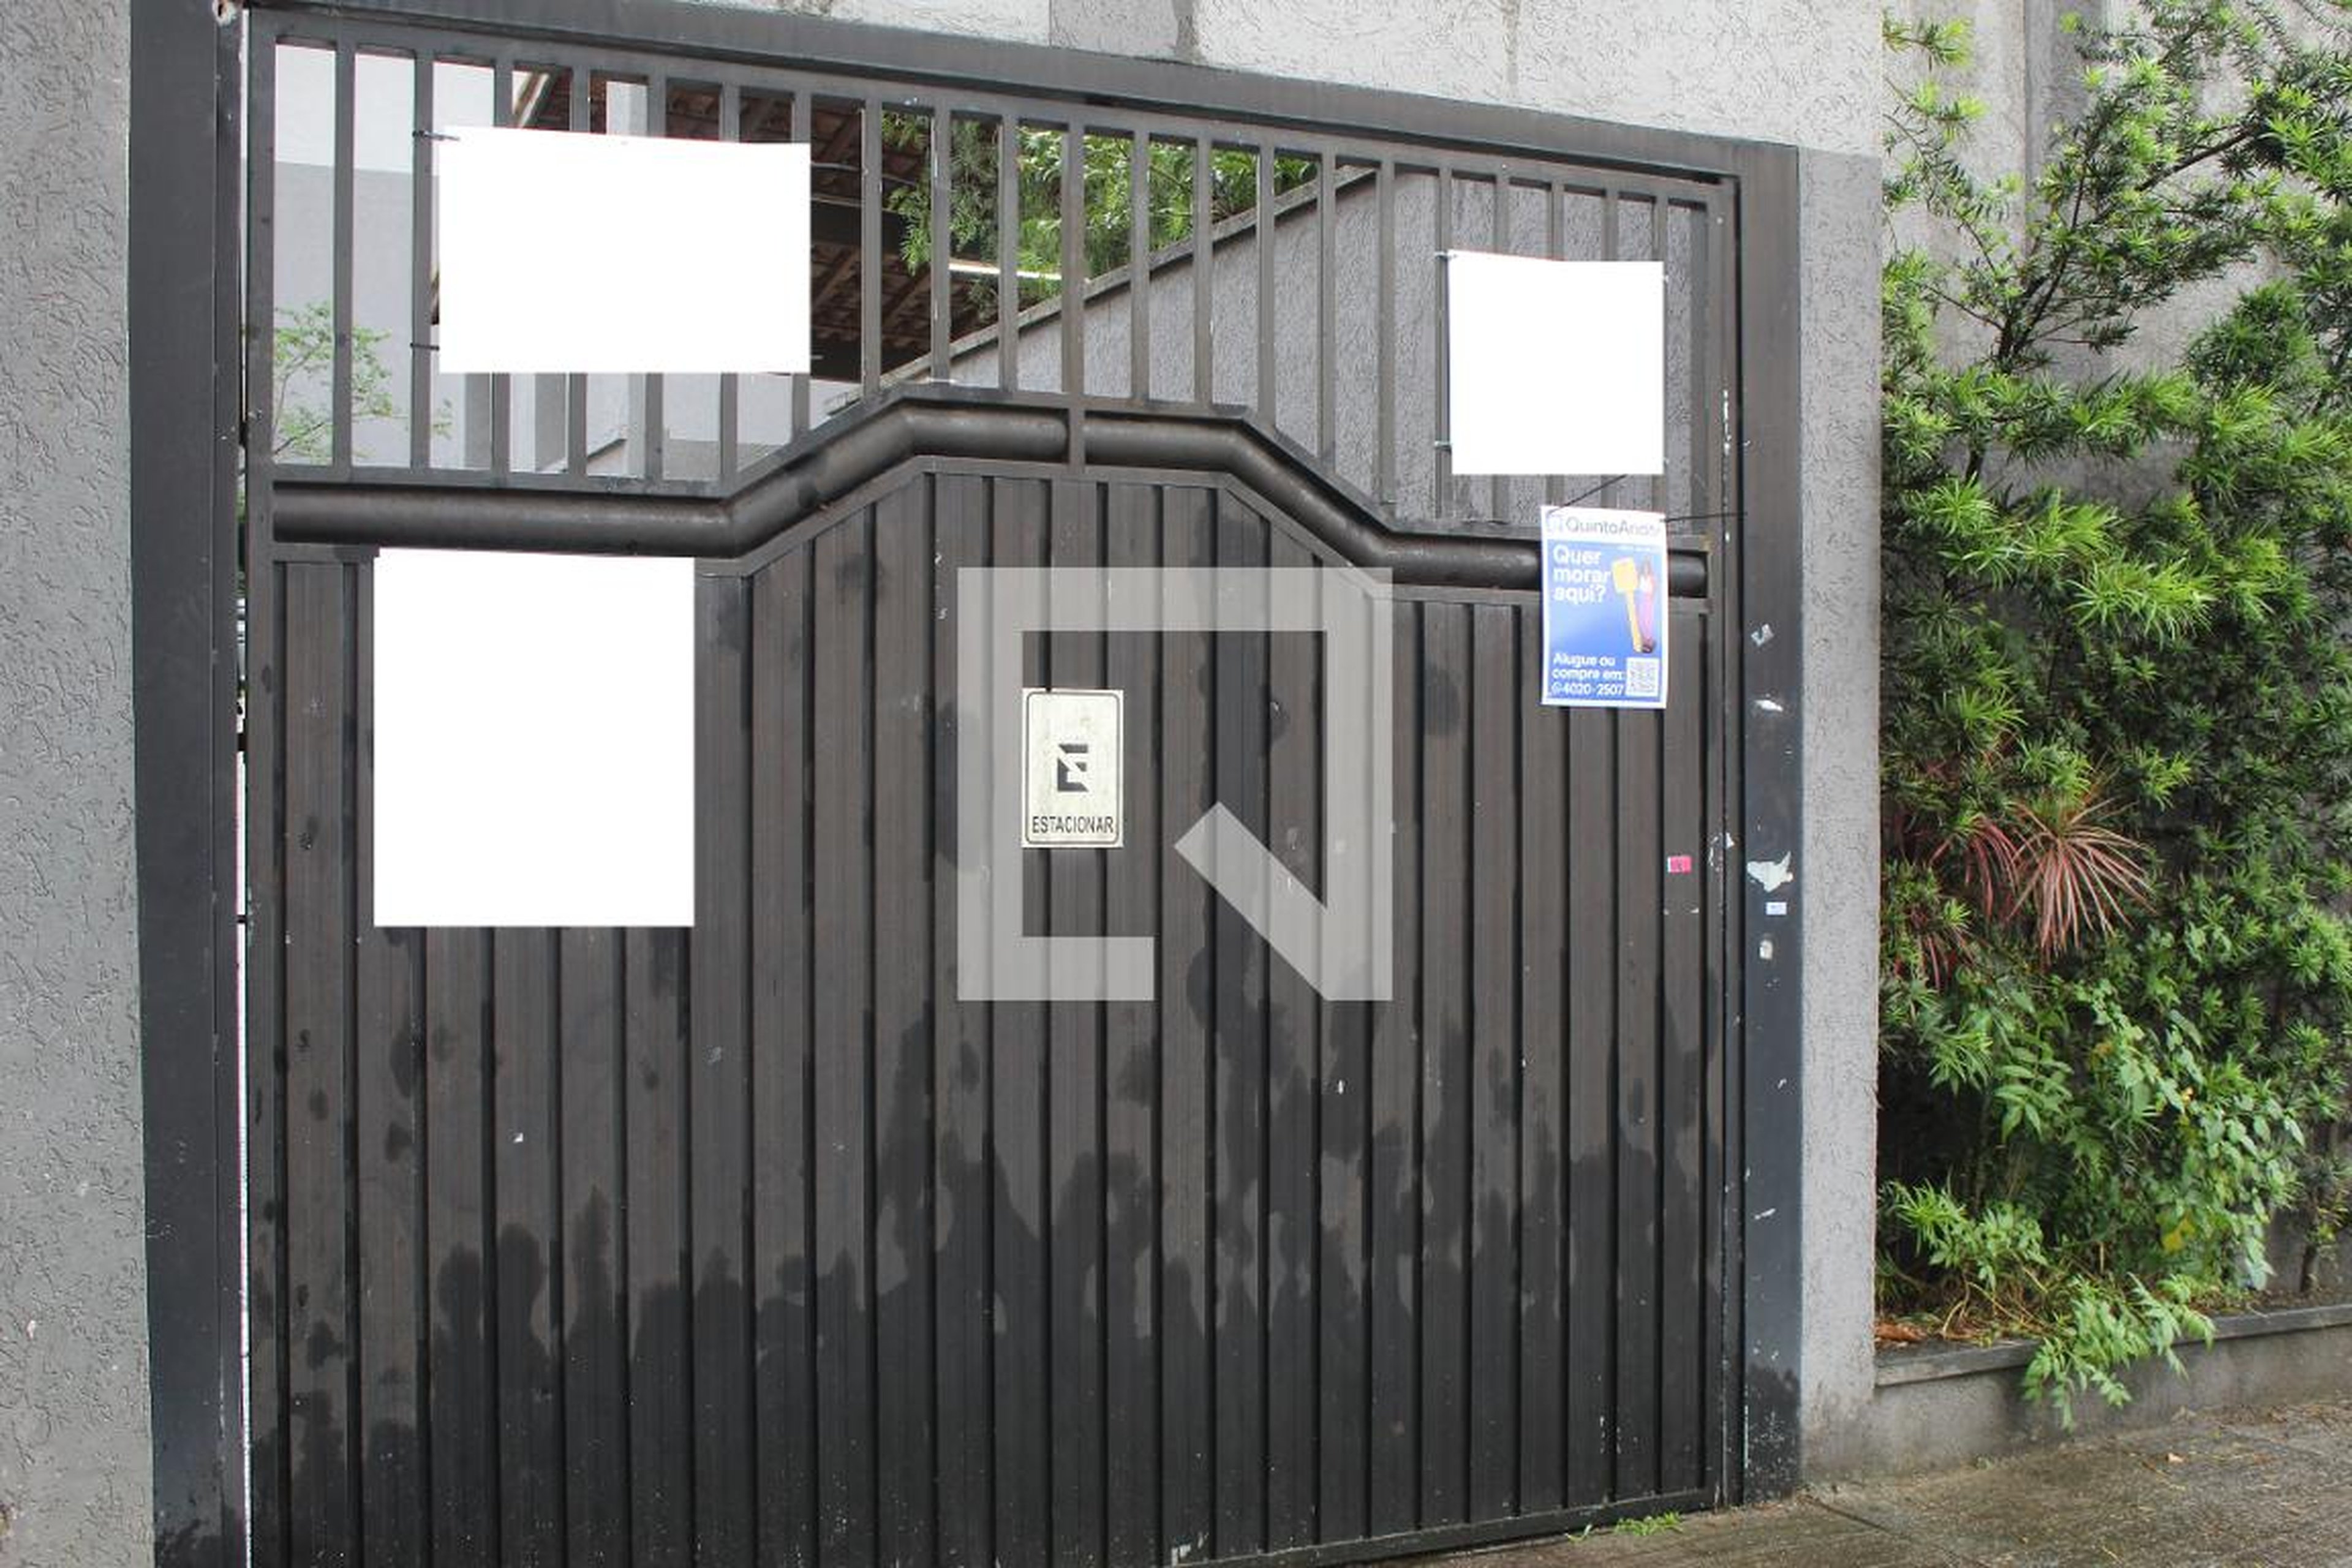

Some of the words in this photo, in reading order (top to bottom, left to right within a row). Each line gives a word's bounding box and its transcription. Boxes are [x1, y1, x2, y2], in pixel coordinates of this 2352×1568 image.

[1553, 545, 1602, 565] Quer
[1553, 567, 1610, 584] morar
[1553, 585, 1607, 604] aqui?
[1553, 652, 1597, 668] Alugue
[1599, 656, 1615, 667] ou
[1552, 668, 1600, 681] compre
[1032, 816, 1114, 834] ESTACIONAR
